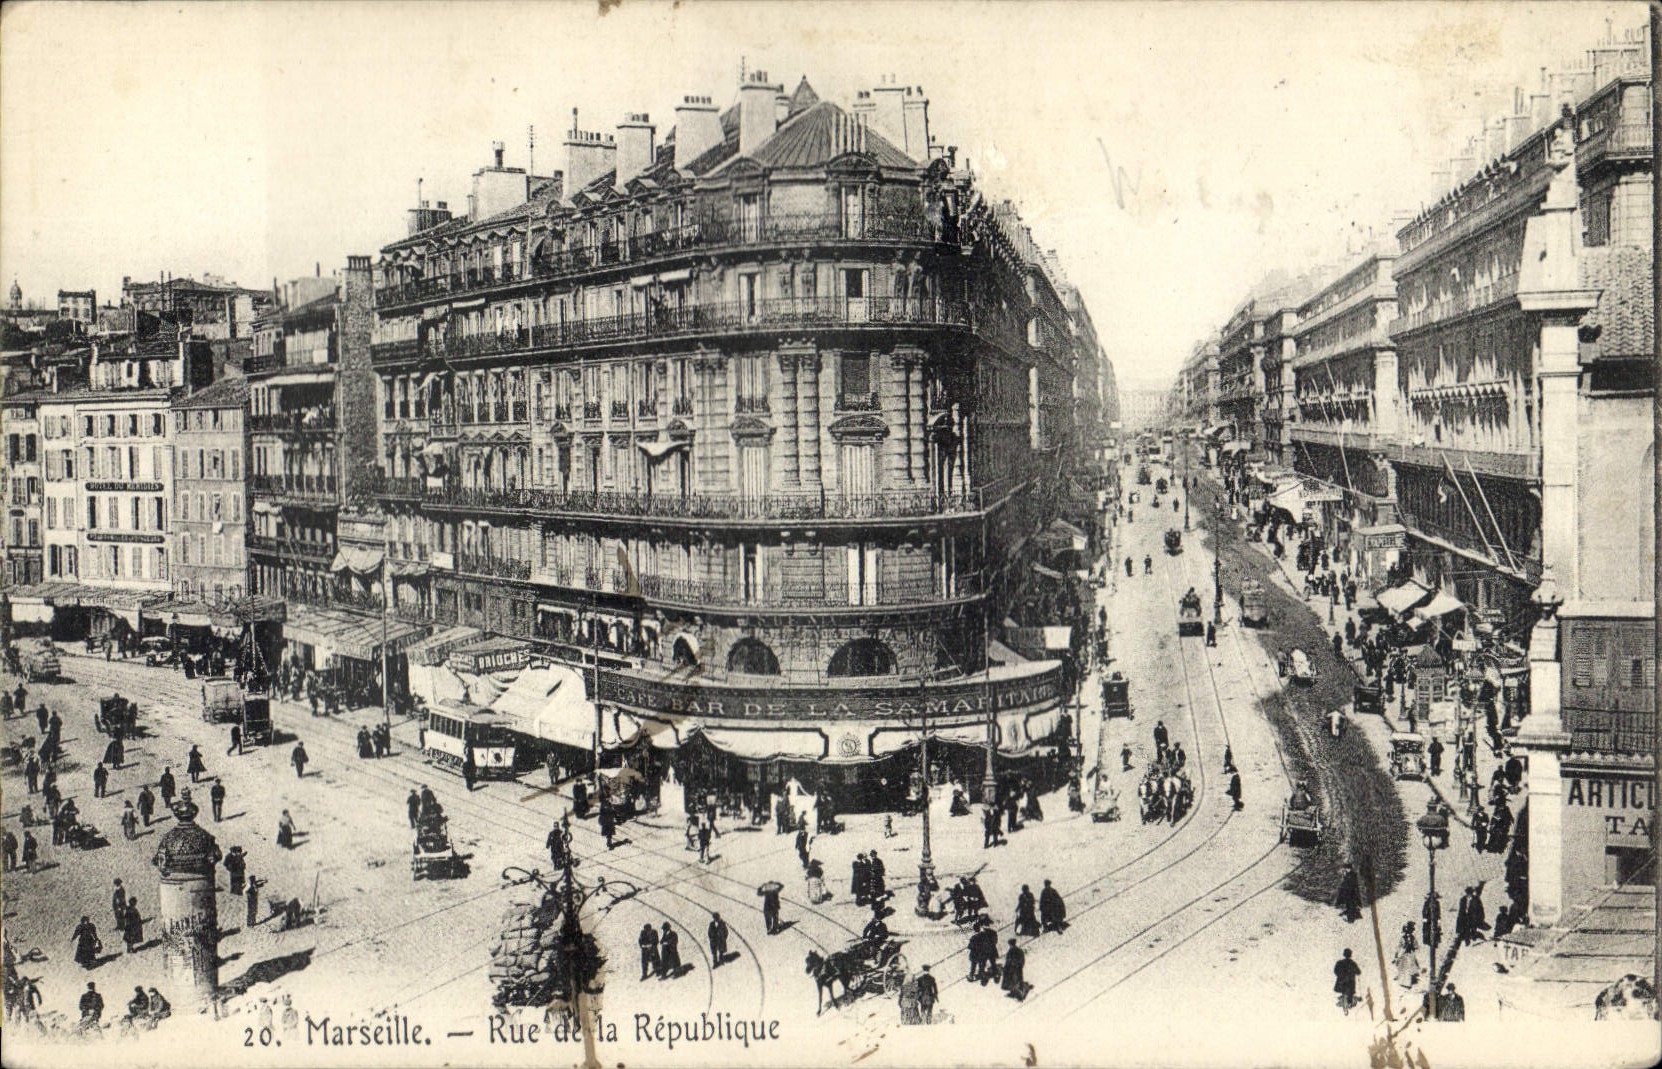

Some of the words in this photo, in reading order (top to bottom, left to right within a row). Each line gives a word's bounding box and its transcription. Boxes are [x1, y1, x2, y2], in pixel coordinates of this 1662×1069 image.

[671, 700, 724, 714] BAR
[744, 702, 786, 716] DE
[807, 702, 855, 716] LA
